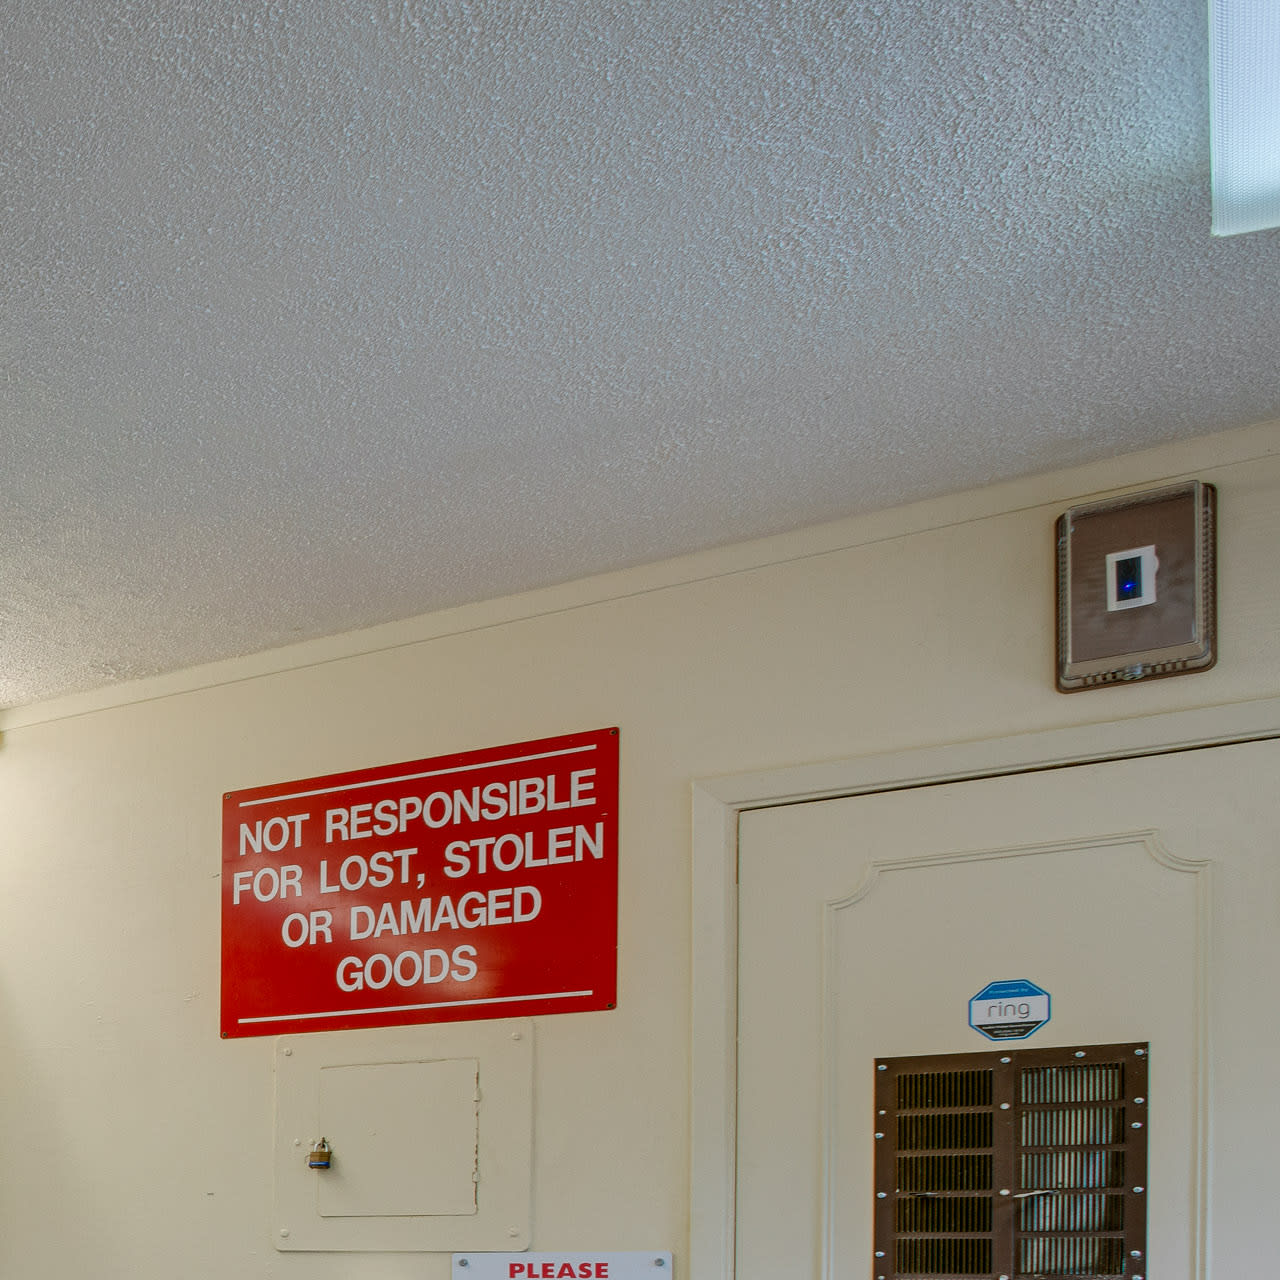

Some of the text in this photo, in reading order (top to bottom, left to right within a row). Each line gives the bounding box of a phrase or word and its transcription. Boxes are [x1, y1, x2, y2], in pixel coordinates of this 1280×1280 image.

[239, 768, 596, 855] NOT RESPONSIBLE
[233, 823, 604, 905] FOR LOST, STOLEN
[282, 886, 541, 947] OR DAMAGED
[336, 945, 477, 992] GOODS
[988, 1002, 1029, 1019] ring
[509, 1262, 609, 1279] PLEASE
